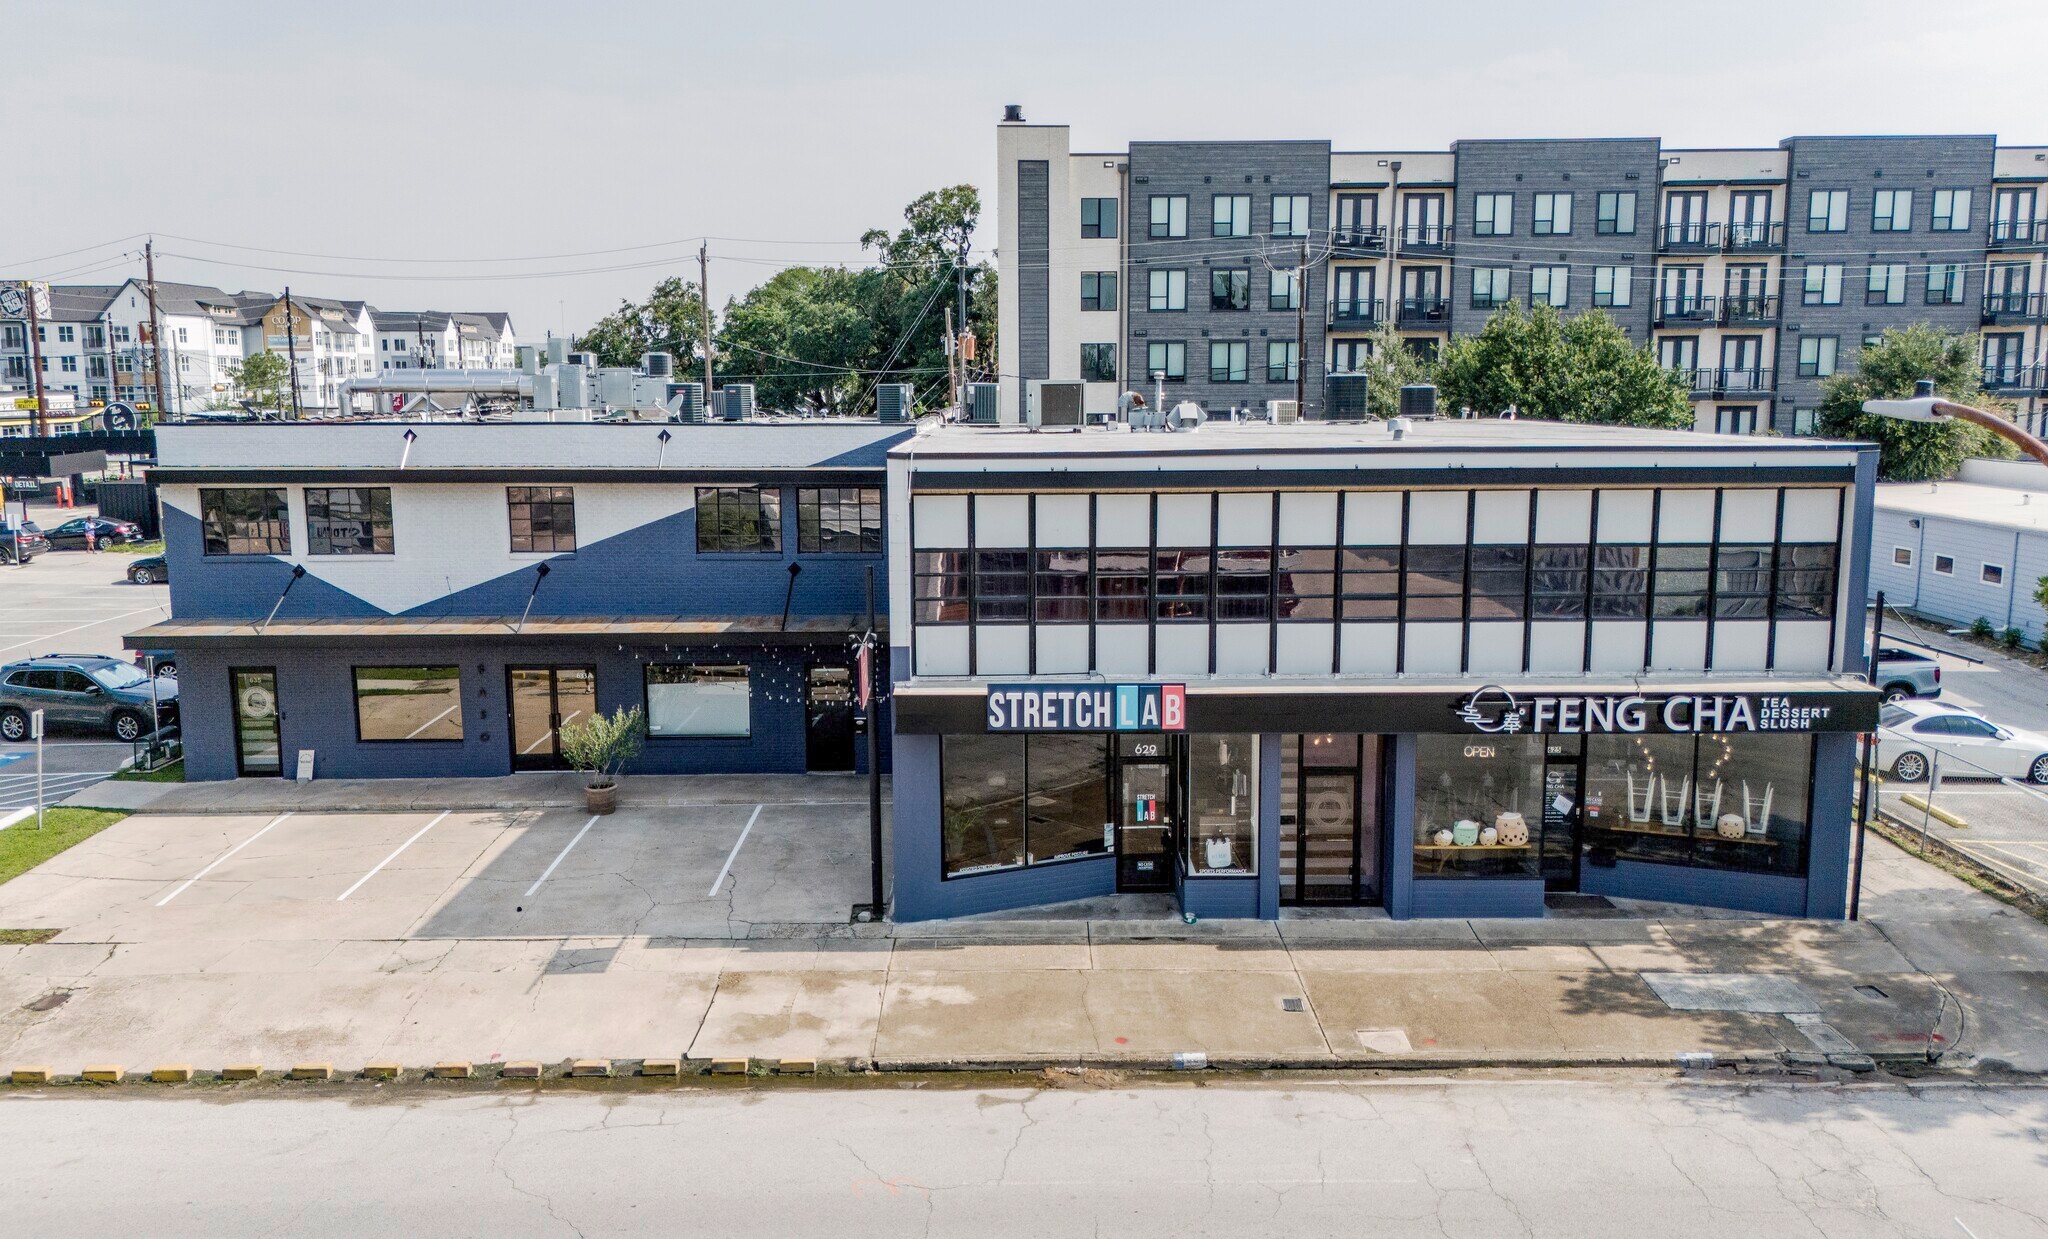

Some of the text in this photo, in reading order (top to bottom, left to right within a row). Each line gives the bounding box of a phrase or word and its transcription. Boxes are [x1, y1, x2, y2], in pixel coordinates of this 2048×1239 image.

[1761, 697, 1790, 708] TEA
[989, 691, 1181, 728] STRETCH LAB
[1533, 695, 1756, 733] FENG CHA
[1760, 708, 1830, 718] DESSERT
[1759, 718, 1810, 729] SLUSH
[1134, 743, 1157, 756] 629
[1463, 746, 1495, 758] OPEN
[1137, 811, 1156, 821] LAB
